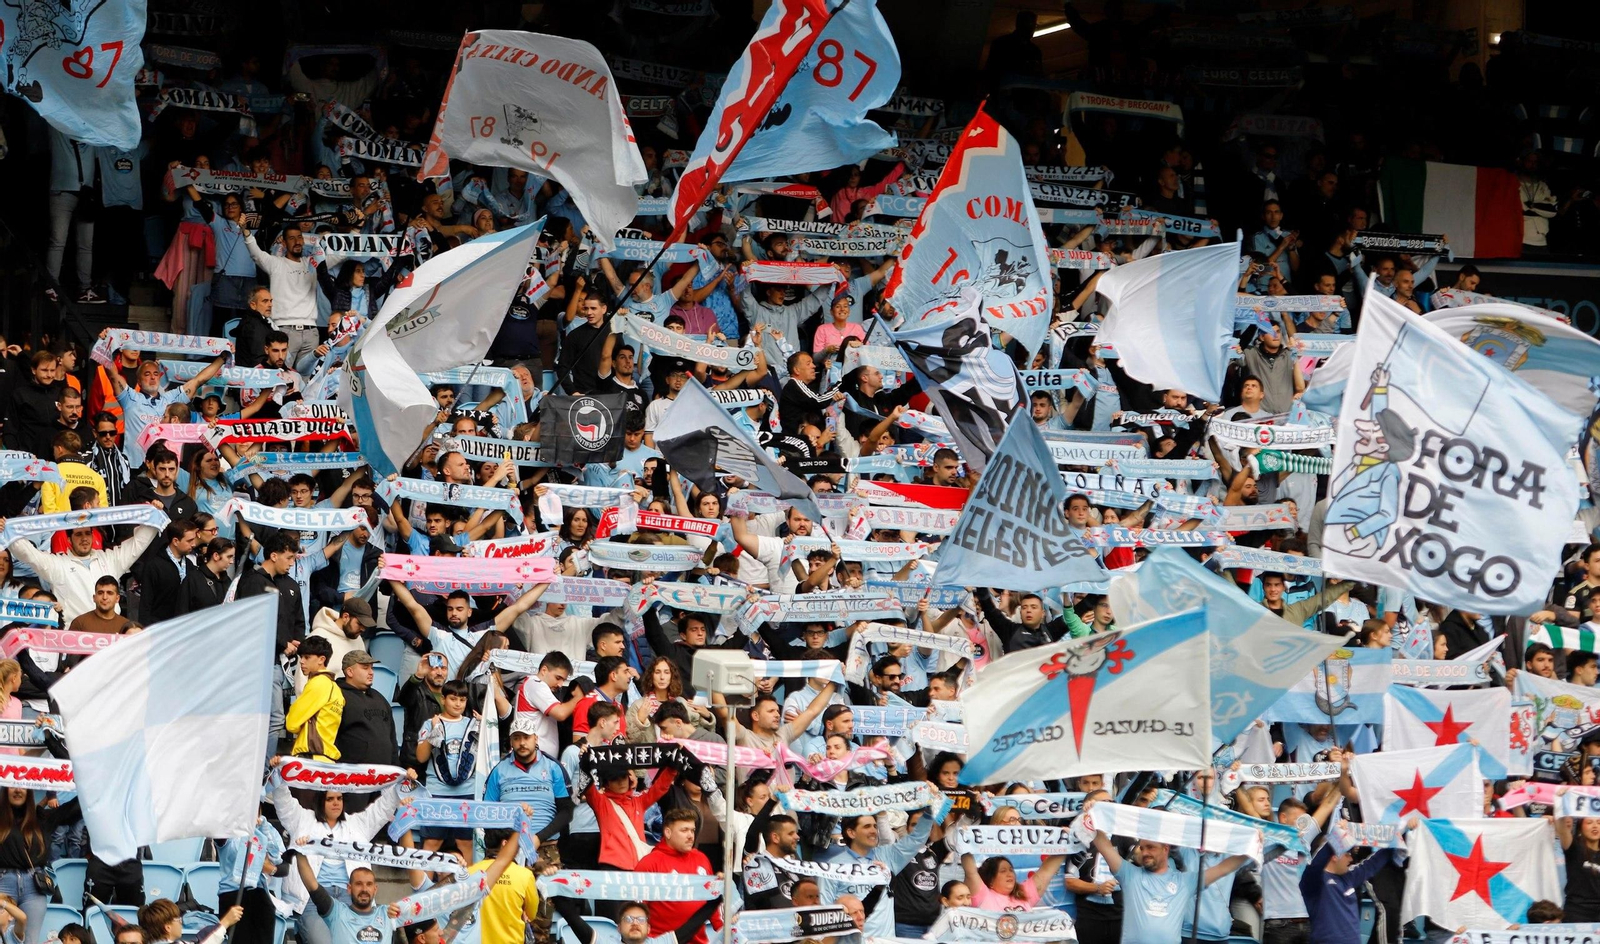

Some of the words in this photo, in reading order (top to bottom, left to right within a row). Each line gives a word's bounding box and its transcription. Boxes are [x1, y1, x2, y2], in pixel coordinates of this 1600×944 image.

[63, 41, 124, 88] 87
[181, 53, 193, 62] DE
[813, 38, 878, 102] 87
[887, 99, 944, 114] AMANS
[355, 138, 424, 165] COMAN
[619, 239, 665, 250] AFOUTEZ
[1069, 250, 1093, 263] VIGO
[132, 331, 203, 349] CELTA
[639, 325, 672, 347] FORA
[675, 338, 692, 353] DE
[697, 345, 730, 362] XOGO
[172, 362, 205, 377] IAG
[221, 367, 271, 383] ASPAS
[1020, 371, 1062, 387] elta
[579, 399, 596, 408] TEIS
[282, 422, 304, 438] DE
[304, 451, 348, 464] CELTA
[461, 438, 513, 460] OLIVEIRA
[516, 445, 533, 462] DE
[1413, 428, 1548, 510] FORA
[1403, 473, 1466, 533] DE
[250, 505, 277, 522] RC
[282, 508, 346, 527] CELTA
[881, 509, 949, 531] CELTA
[1379, 526, 1523, 598] XOGO
[6, 602, 51, 619] PARTY
[1415, 664, 1431, 679] DE
[1435, 665, 1467, 679] XOGO
[919, 727, 958, 747] FORA
[420, 806, 458, 822] R.C.
[601, 886, 608, 899] E
